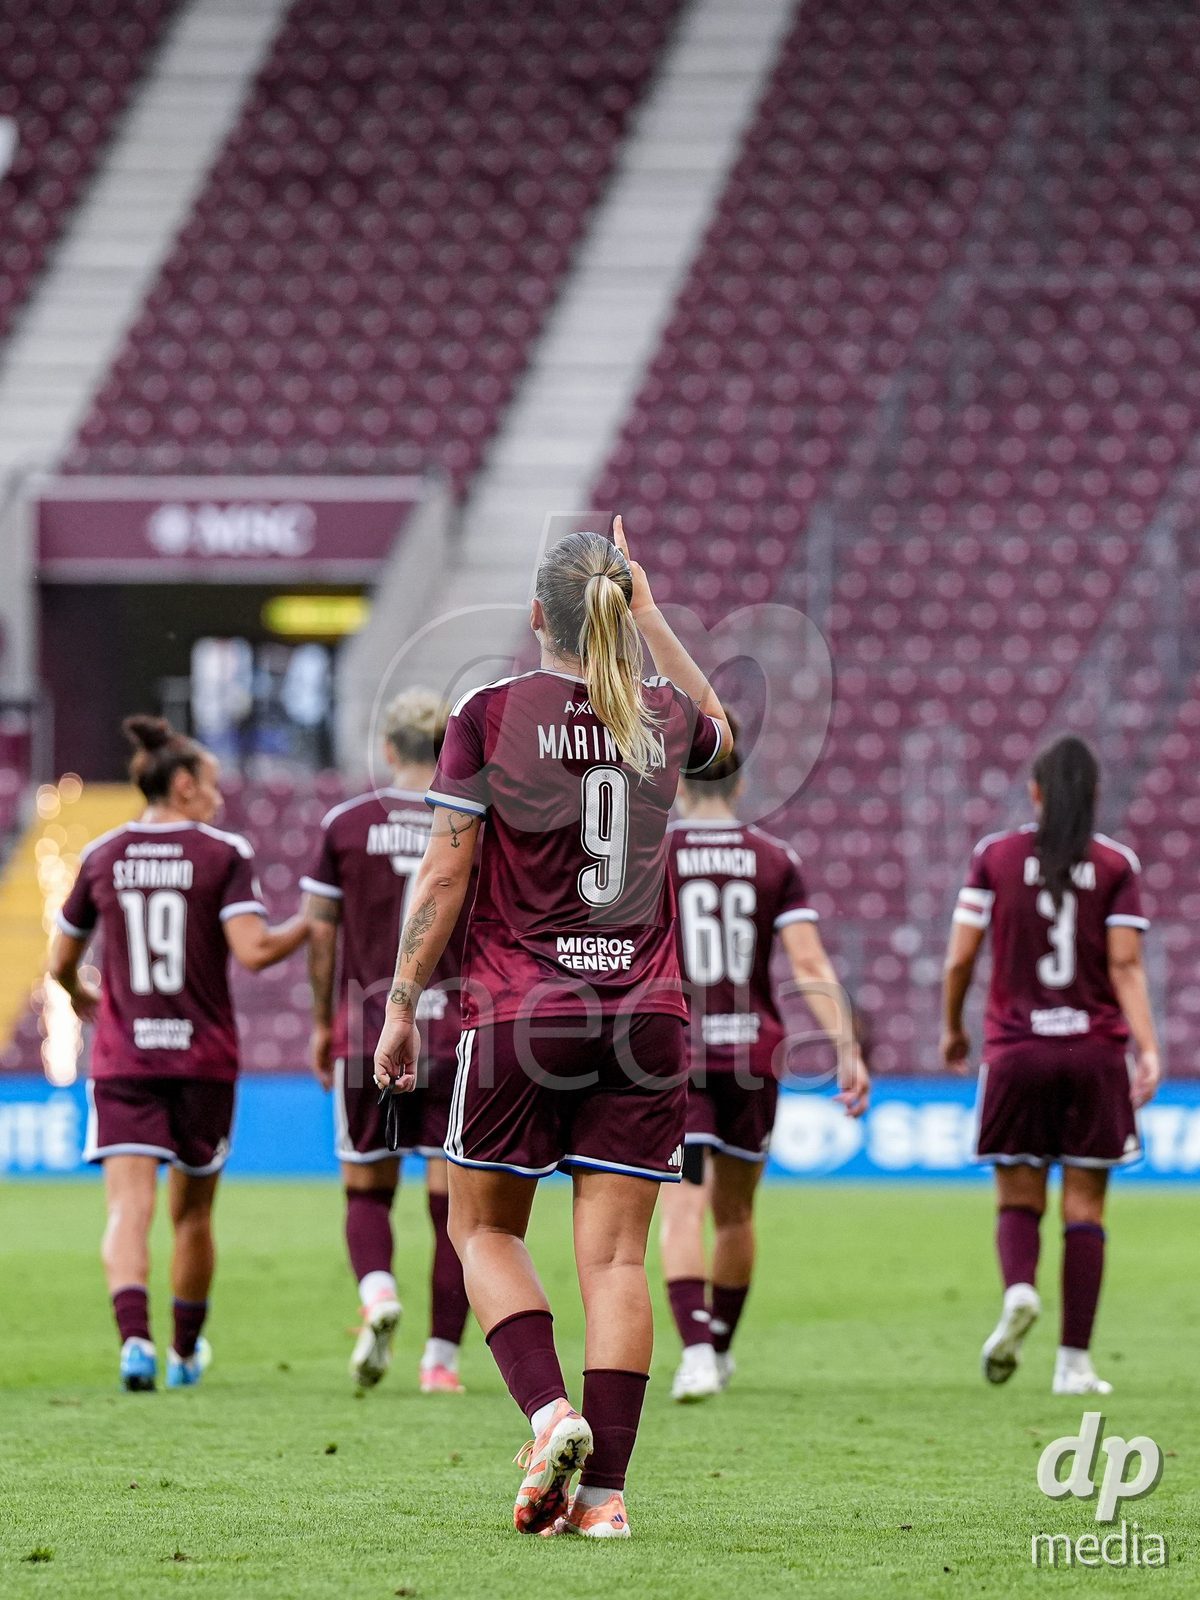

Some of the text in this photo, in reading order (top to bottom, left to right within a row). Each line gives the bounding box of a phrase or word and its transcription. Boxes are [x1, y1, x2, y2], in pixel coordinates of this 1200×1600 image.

[537, 724, 667, 769] MARINLI
[577, 765, 630, 908] 9
[117, 889, 188, 995] 19
[556, 936, 636, 956] MIGROS
[557, 952, 633, 972] GENÈVE
[678, 878, 758, 988] 66
[1036, 887, 1078, 989] 3
